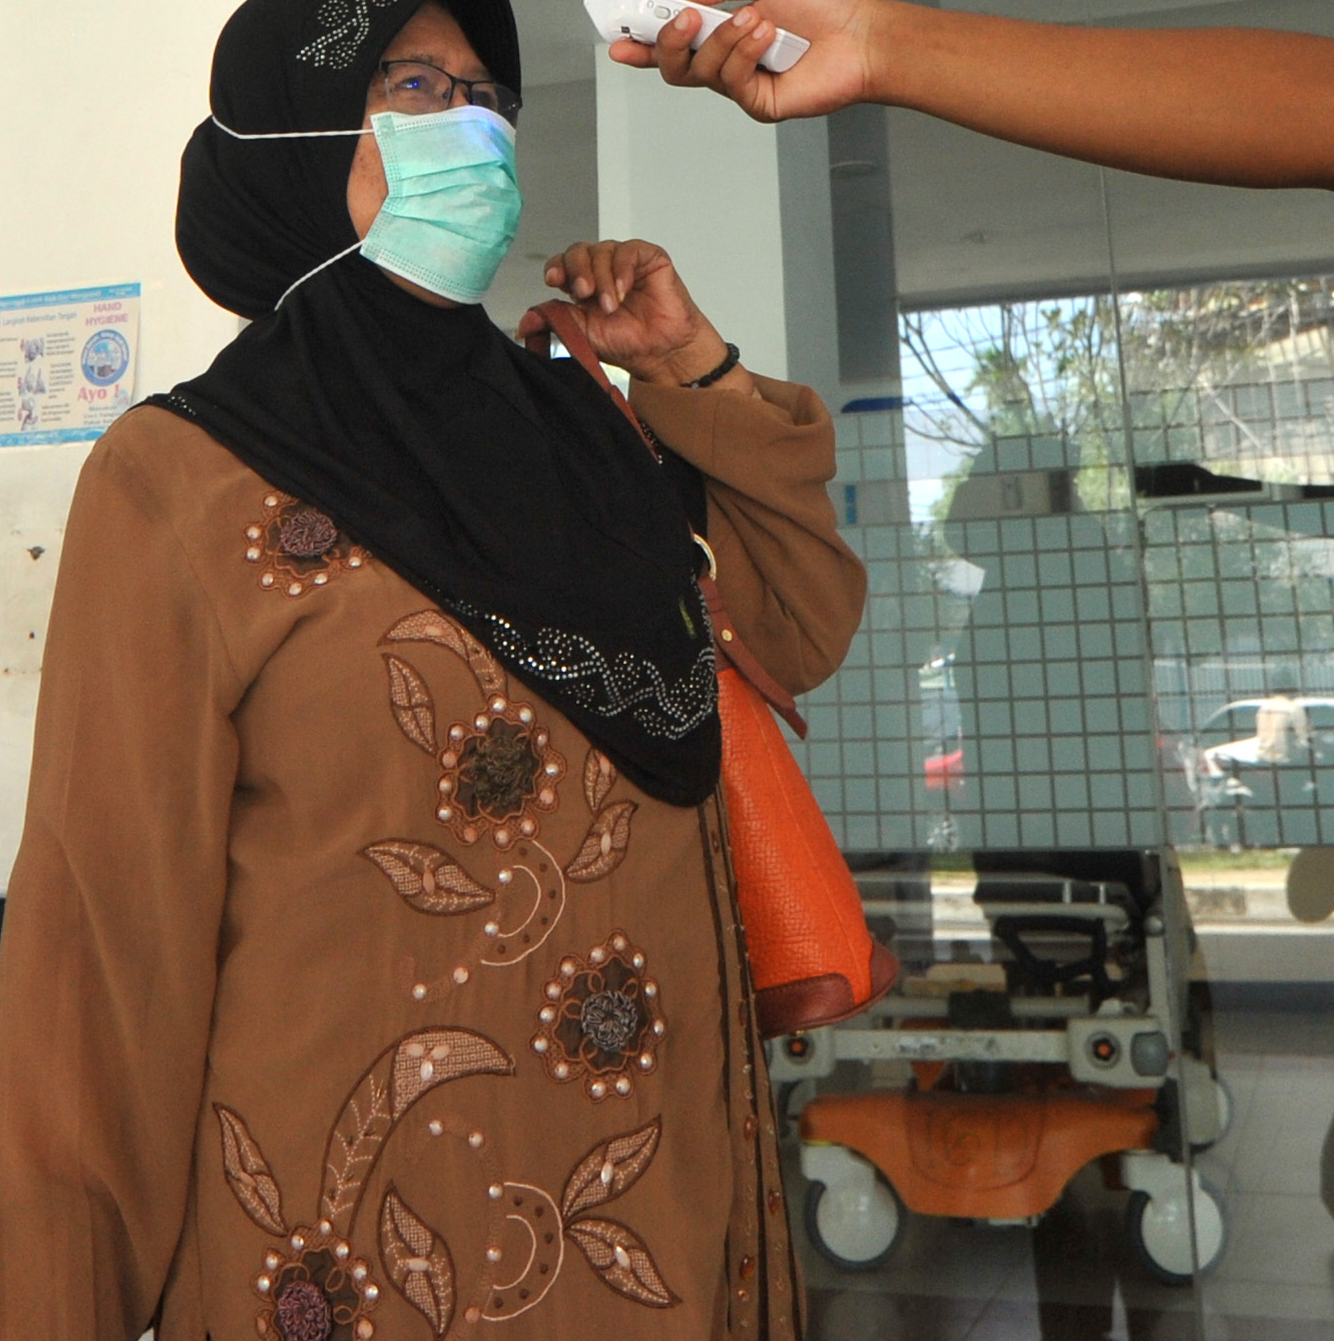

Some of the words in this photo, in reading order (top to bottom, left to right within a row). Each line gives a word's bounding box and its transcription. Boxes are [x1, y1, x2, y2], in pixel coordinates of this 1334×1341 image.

[93, 302, 122, 313] HAND
[85, 313, 129, 327] HYGIENE
[77, 386, 108, 404] Ayo
